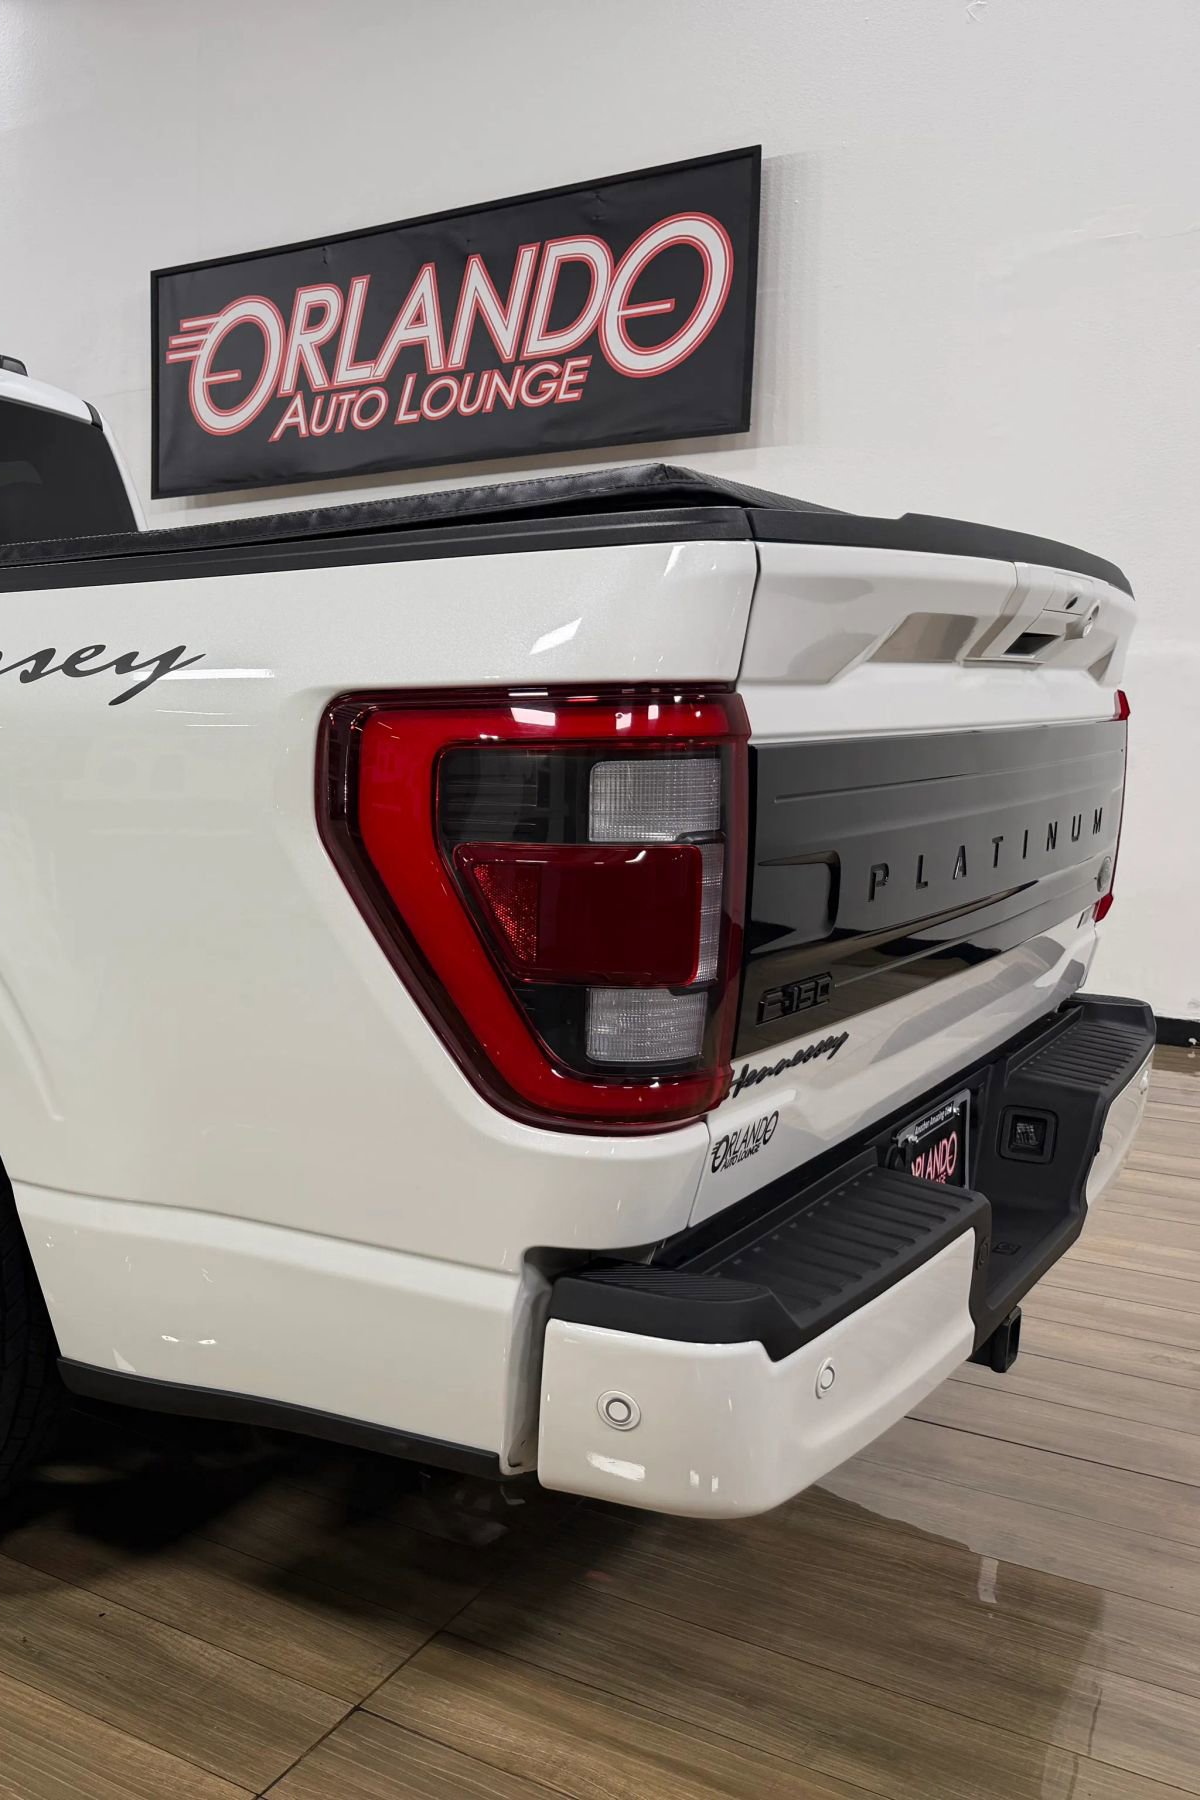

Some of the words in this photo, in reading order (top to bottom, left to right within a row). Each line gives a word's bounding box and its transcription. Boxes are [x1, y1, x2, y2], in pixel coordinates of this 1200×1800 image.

[186, 211, 734, 435] ORLANDO
[268, 389, 388, 442] AUTO
[394, 355, 593, 425] LOUNGE
[868, 807, 1103, 902] PLATINUM
[711, 1110, 779, 1173] ORLANDO
[911, 1131, 958, 1180] RLANDO
